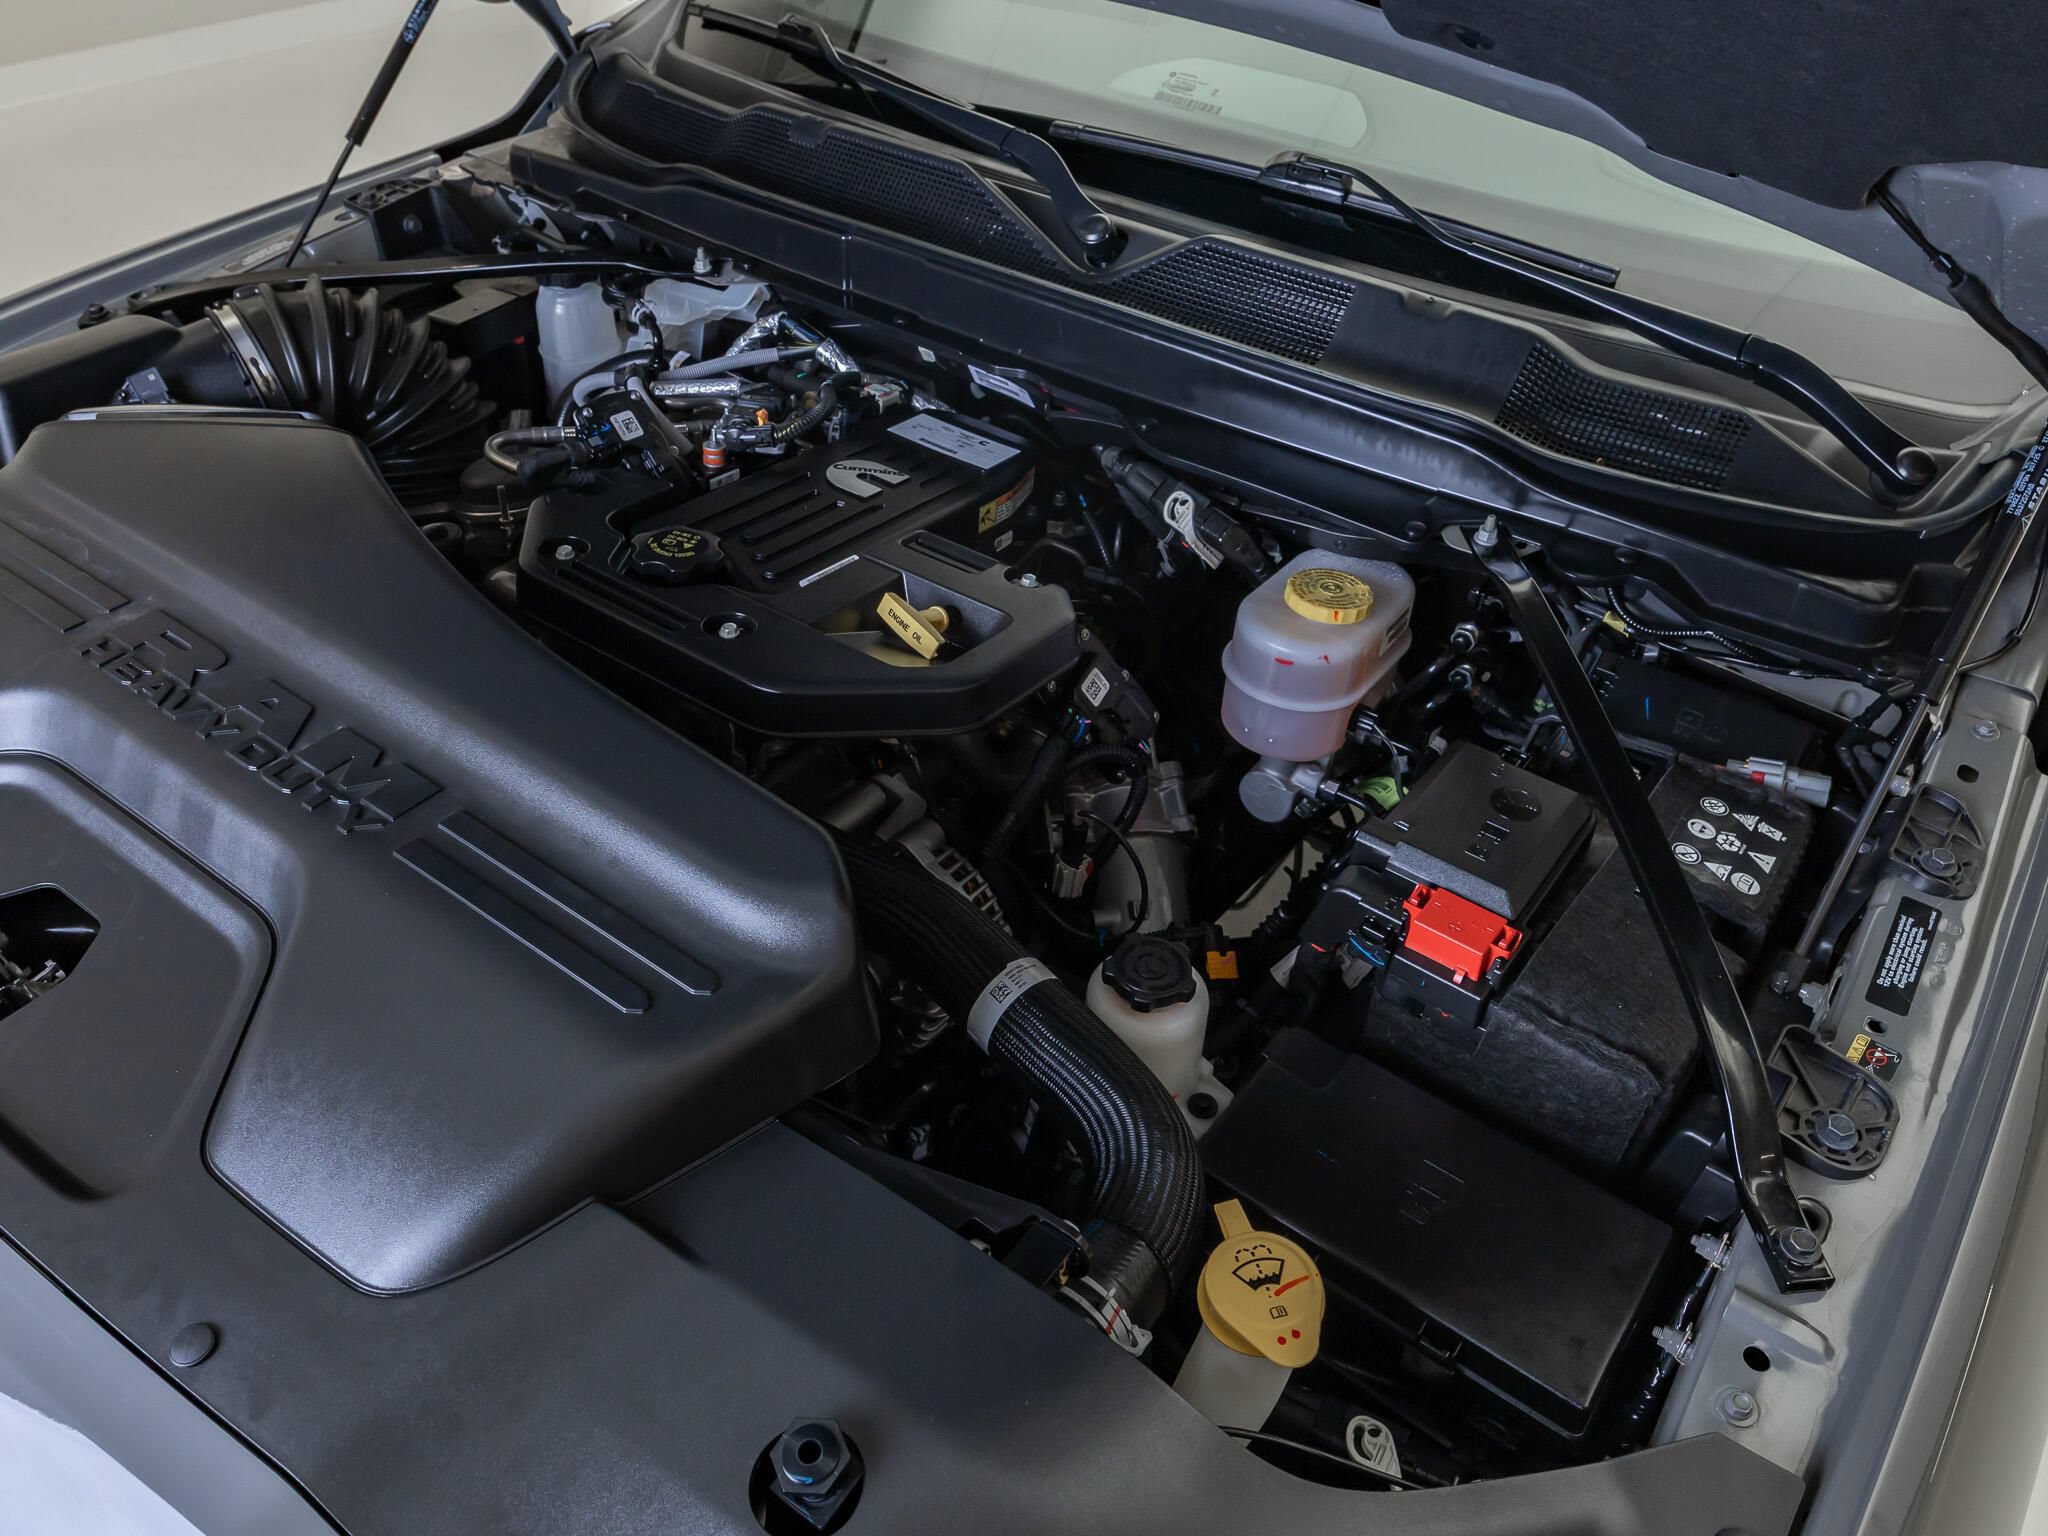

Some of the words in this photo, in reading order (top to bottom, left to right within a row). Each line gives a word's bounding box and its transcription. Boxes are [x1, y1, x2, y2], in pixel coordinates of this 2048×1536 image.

[888, 608, 911, 633] ENGINE
[911, 631, 922, 645] OIL
[80, 634, 241, 740] HEAVY
[224, 732, 388, 835] DUTY
[102, 609, 443, 822] RAM
[1884, 976, 1892, 987] 12V
